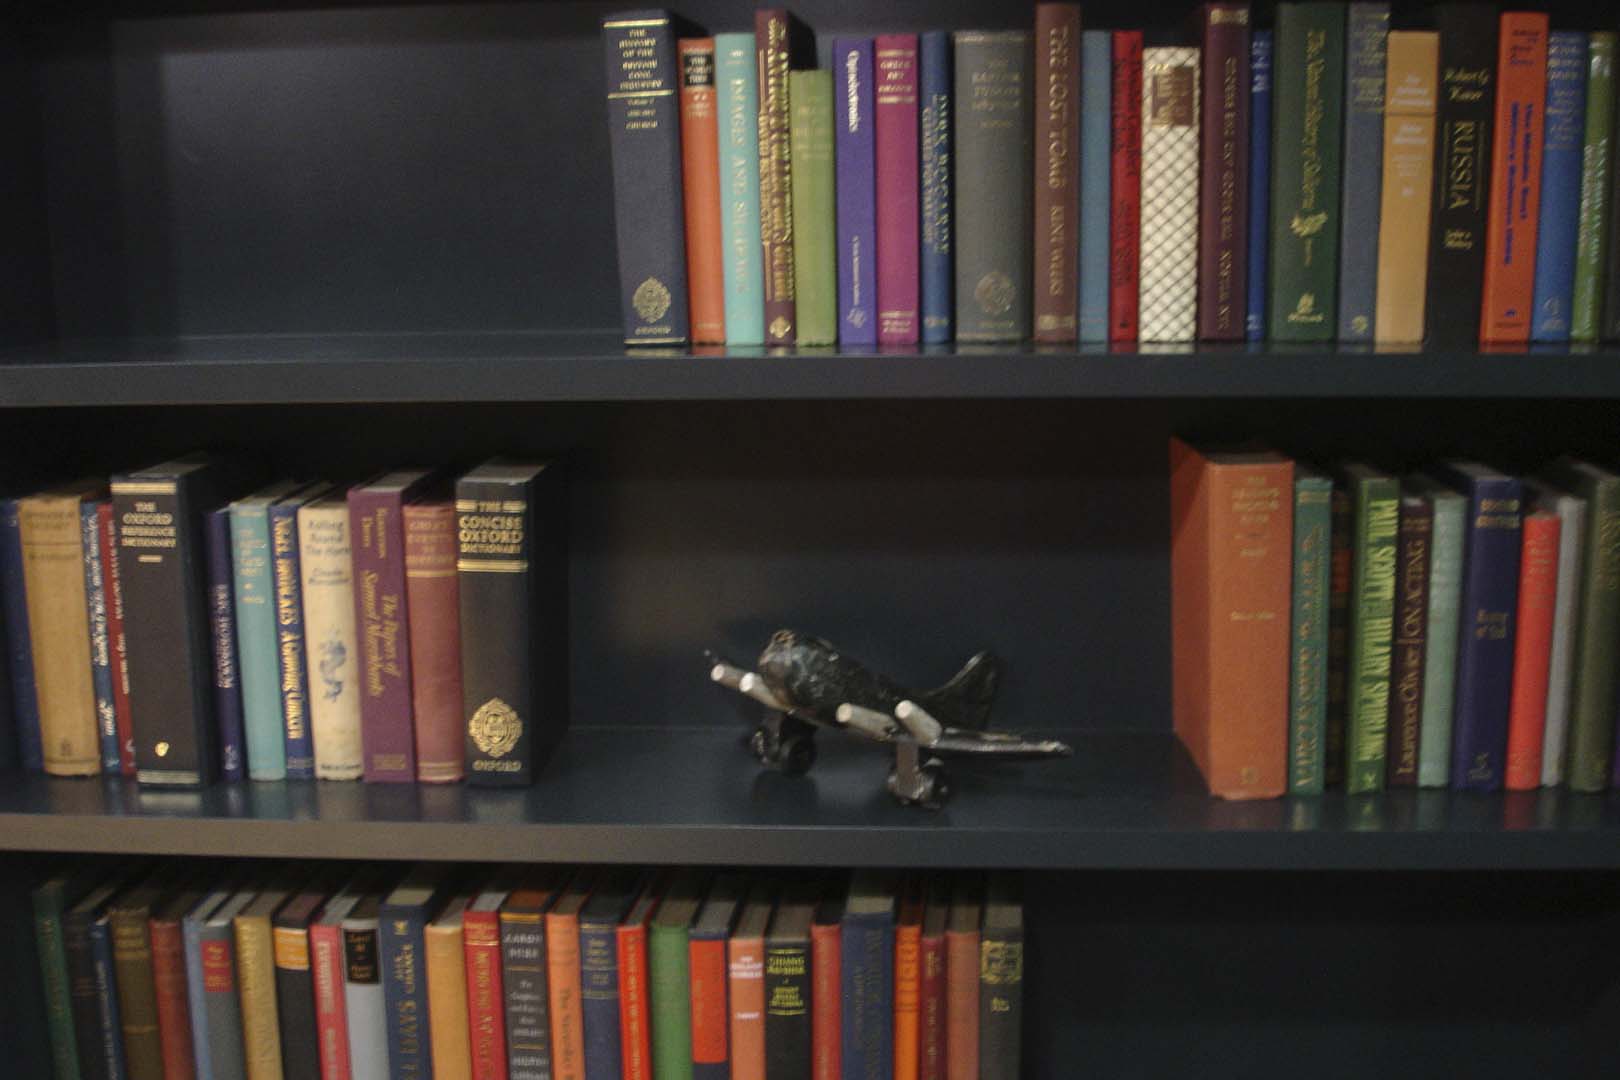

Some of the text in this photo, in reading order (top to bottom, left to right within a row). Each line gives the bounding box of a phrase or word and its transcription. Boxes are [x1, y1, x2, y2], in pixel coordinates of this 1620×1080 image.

[1452, 120, 1475, 210] RUSSIA
[135, 502, 156, 512] THE
[476, 501, 502, 512] THE
[122, 513, 173, 525] OXFORD
[459, 515, 523, 529] CONCISE
[121, 526, 176, 537] REFERENCE
[459, 530, 524, 543] OXFORD
[121, 537, 177, 549] DICTIONARY
[1357, 499, 1399, 761] PAUL SCOTT HILARY SPURLING
[472, 760, 522, 772] OXFORD
